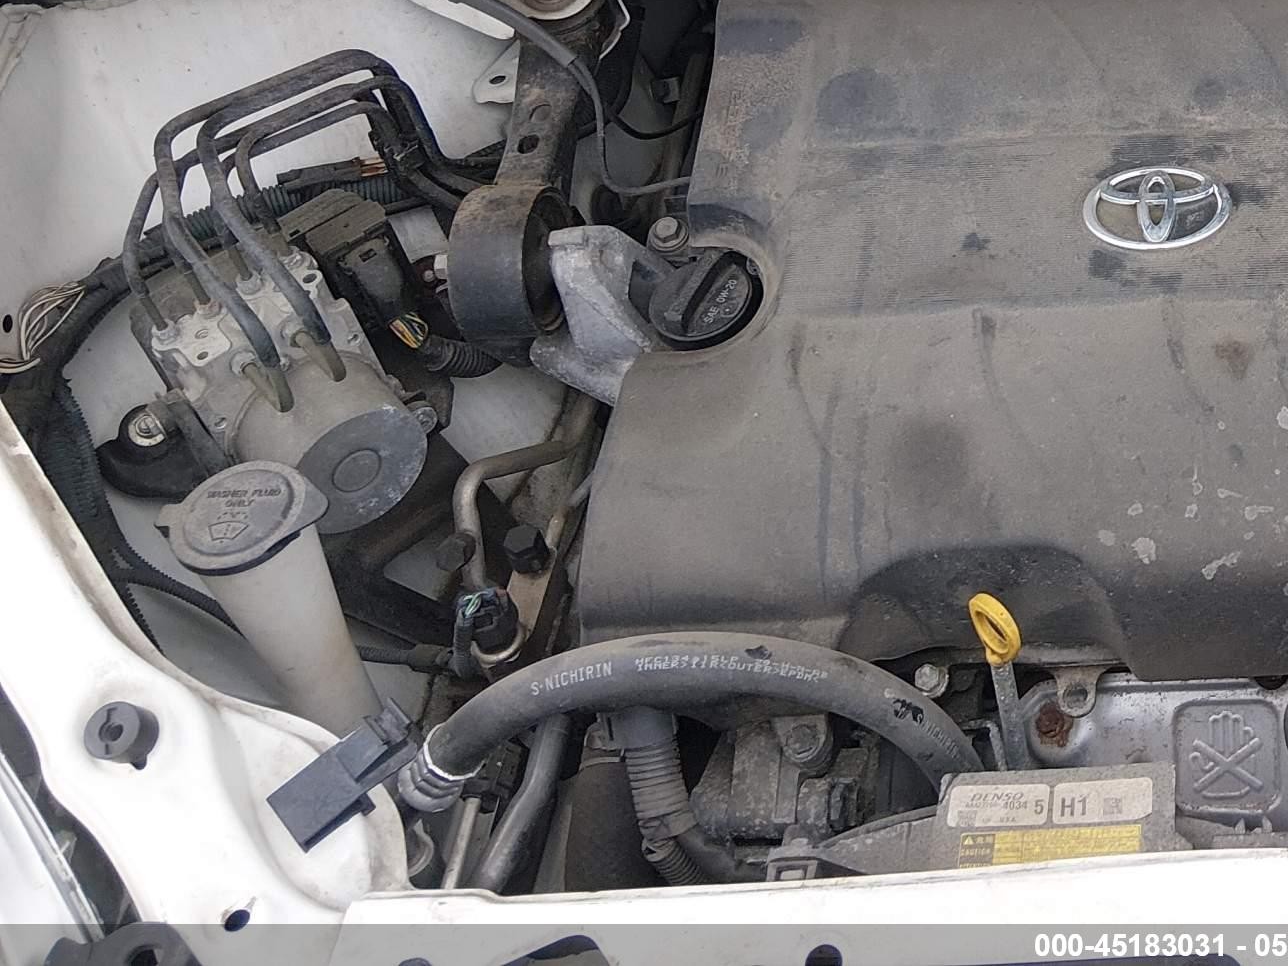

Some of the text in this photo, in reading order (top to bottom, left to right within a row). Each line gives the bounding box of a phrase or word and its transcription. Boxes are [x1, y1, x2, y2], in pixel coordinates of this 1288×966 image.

[703, 279, 737, 323] SAE 0W-20
[252, 488, 282, 497] FLUID
[225, 499, 255, 507] ONLY
[970, 791, 1025, 802] DENSO
[1033, 799, 1045, 815] 5
[1060, 797, 1087, 817] H1
